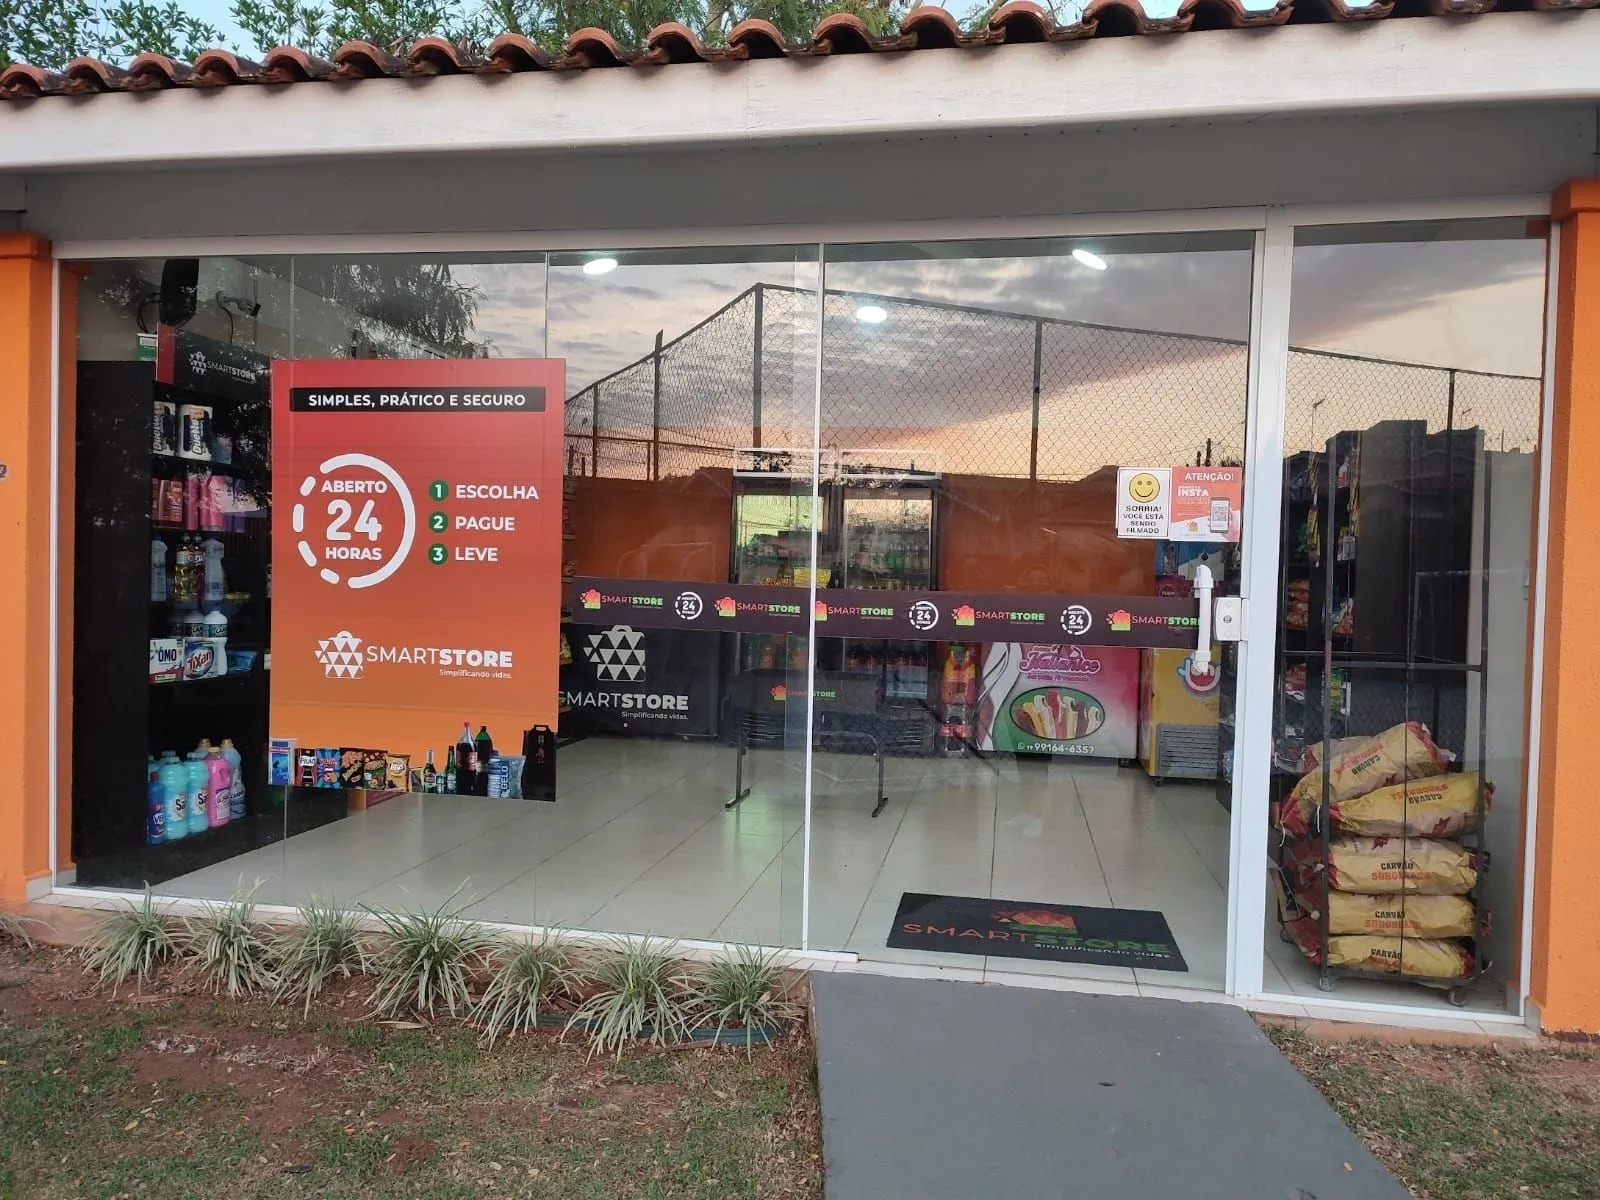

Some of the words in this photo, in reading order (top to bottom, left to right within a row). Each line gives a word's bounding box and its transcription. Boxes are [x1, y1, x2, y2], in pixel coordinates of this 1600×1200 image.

[207, 361, 256, 381] SMARTSTORE
[308, 394, 376, 408] SIMPLES,
[380, 391, 445, 407] PRÁTICO
[450, 394, 458, 407] E
[463, 394, 526, 407] SEGURO
[1184, 471, 1234, 483] ATENÇÃO!
[321, 480, 388, 494] ABERTO
[434, 484, 442, 498] 1
[455, 484, 539, 501] ESCOLHA
[1177, 489, 1210, 497] INSTA
[326, 499, 383, 542] 24
[433, 515, 444, 530] 2
[455, 516, 516, 531] PAGUE
[325, 547, 383, 561] HORAS
[433, 547, 444, 562] 3
[455, 547, 498, 562] LEVE
[601, 595, 664, 606] SMARTSTORE
[682, 600, 696, 611] 24
[737, 602, 801, 614] SMARTSTORE
[828, 606, 894, 617] SMARTSTORE
[916, 610, 931, 621] 24
[975, 610, 1046, 621] SMARTSTORE
[1068, 614, 1084, 626] 24
[1132, 615, 1200, 626] SMARTSTOR
[366, 645, 513, 668] SMARTSTORE
[439, 668, 490, 679] Simplificando
[492, 670, 513, 679] vidas.
[621, 711, 668, 720] Simplificando
[1034, 742, 1095, 754] 99164-6357
[903, 923, 1169, 953] SMARTSTORE
